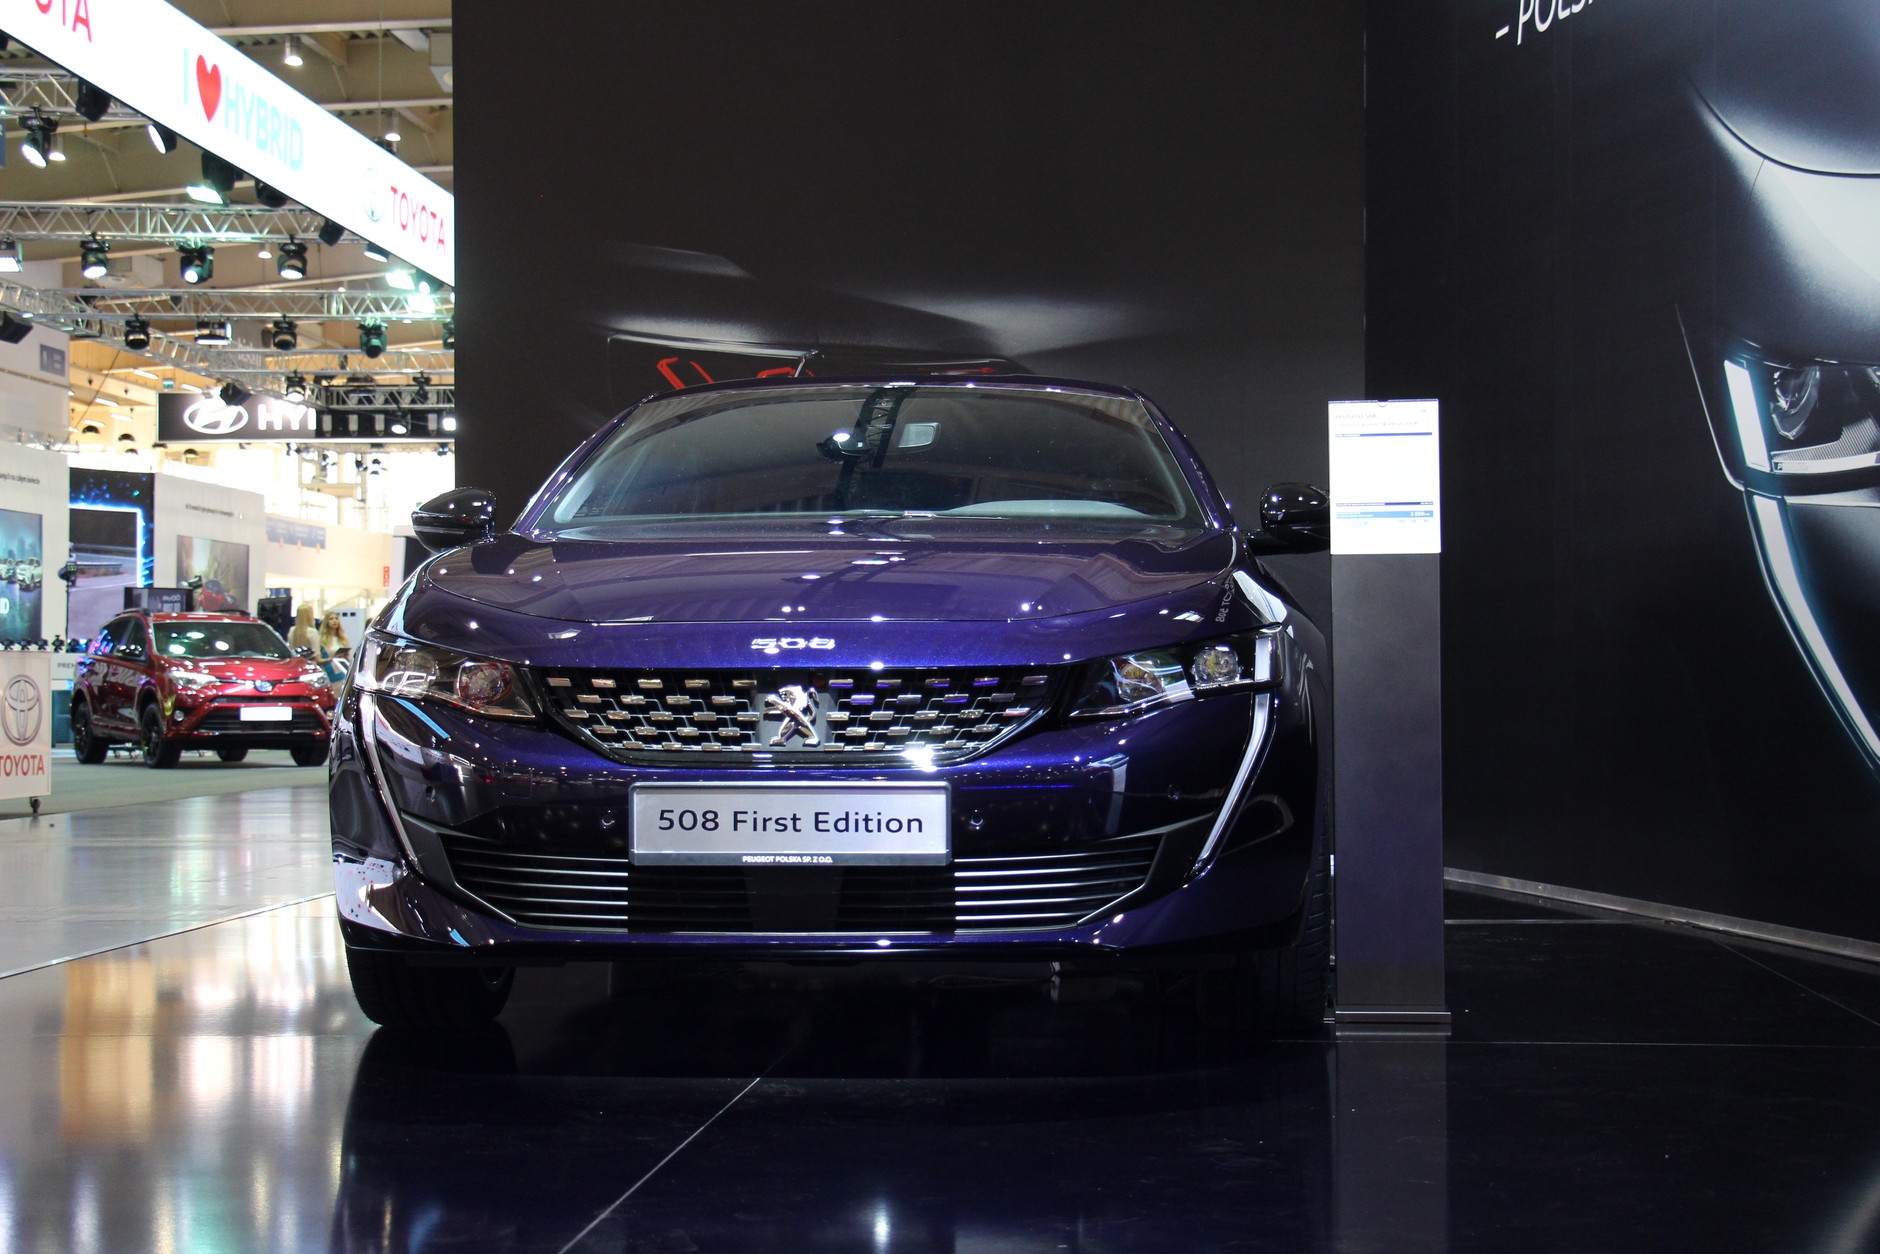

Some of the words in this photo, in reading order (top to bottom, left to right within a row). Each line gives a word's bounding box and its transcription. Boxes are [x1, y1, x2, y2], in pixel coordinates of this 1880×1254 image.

[183, 47, 190, 105] I
[224, 74, 304, 171] HYBRID
[390, 185, 446, 254] TOYOTA
[751, 637, 836, 650] 508
[0, 754, 45, 777] TOYOTA
[658, 810, 720, 831] 508
[733, 811, 802, 833] First
[814, 811, 923, 833] Edition
[742, 855, 775, 863] PEUGEOT
[775, 855, 802, 863] POLSKA
